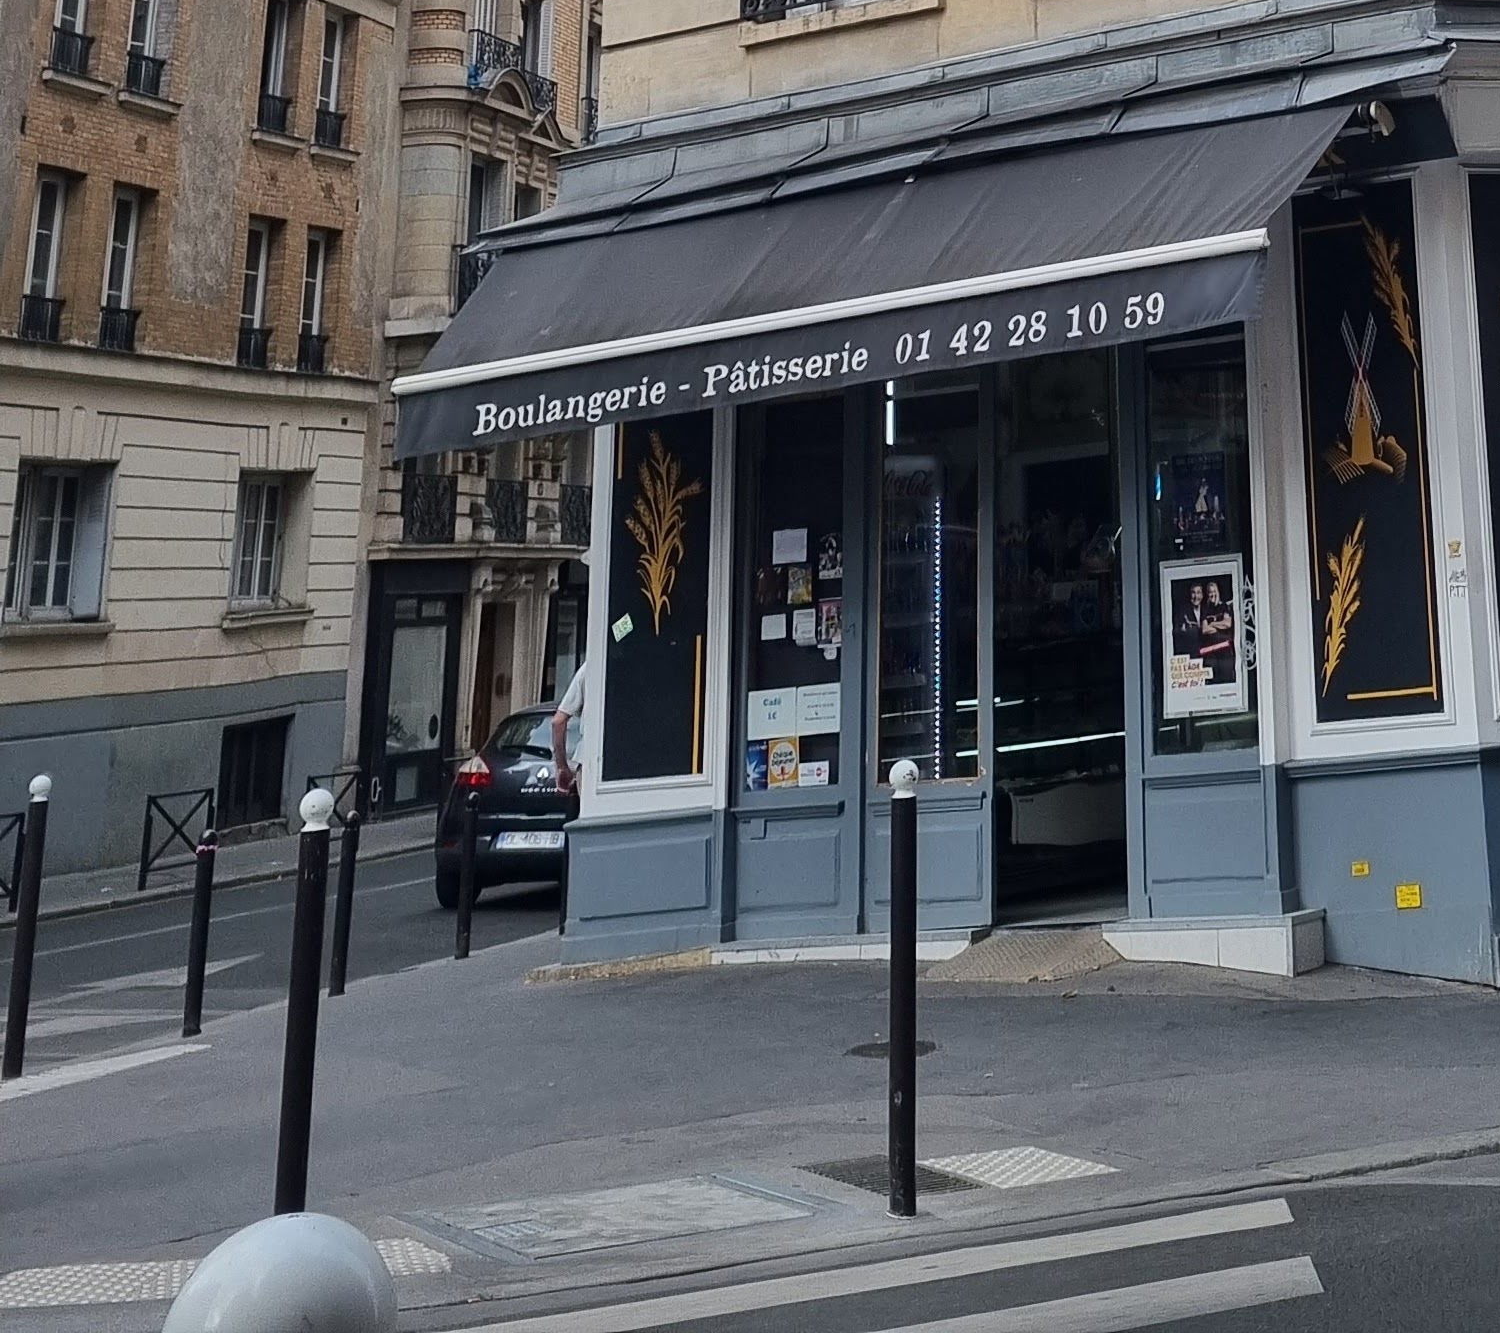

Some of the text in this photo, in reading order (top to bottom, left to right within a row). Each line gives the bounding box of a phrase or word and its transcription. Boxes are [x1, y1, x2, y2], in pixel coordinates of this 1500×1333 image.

[472, 375, 667, 437] Boulangerie
[701, 340, 869, 398] Pâtisserie
[895, 329, 932, 365] 01
[949, 320, 993, 357] 42
[1007, 310, 1048, 348] 28
[1065, 301, 1108, 339] 10
[1123, 291, 1166, 330] 59
[763, 697, 782, 707] Café
